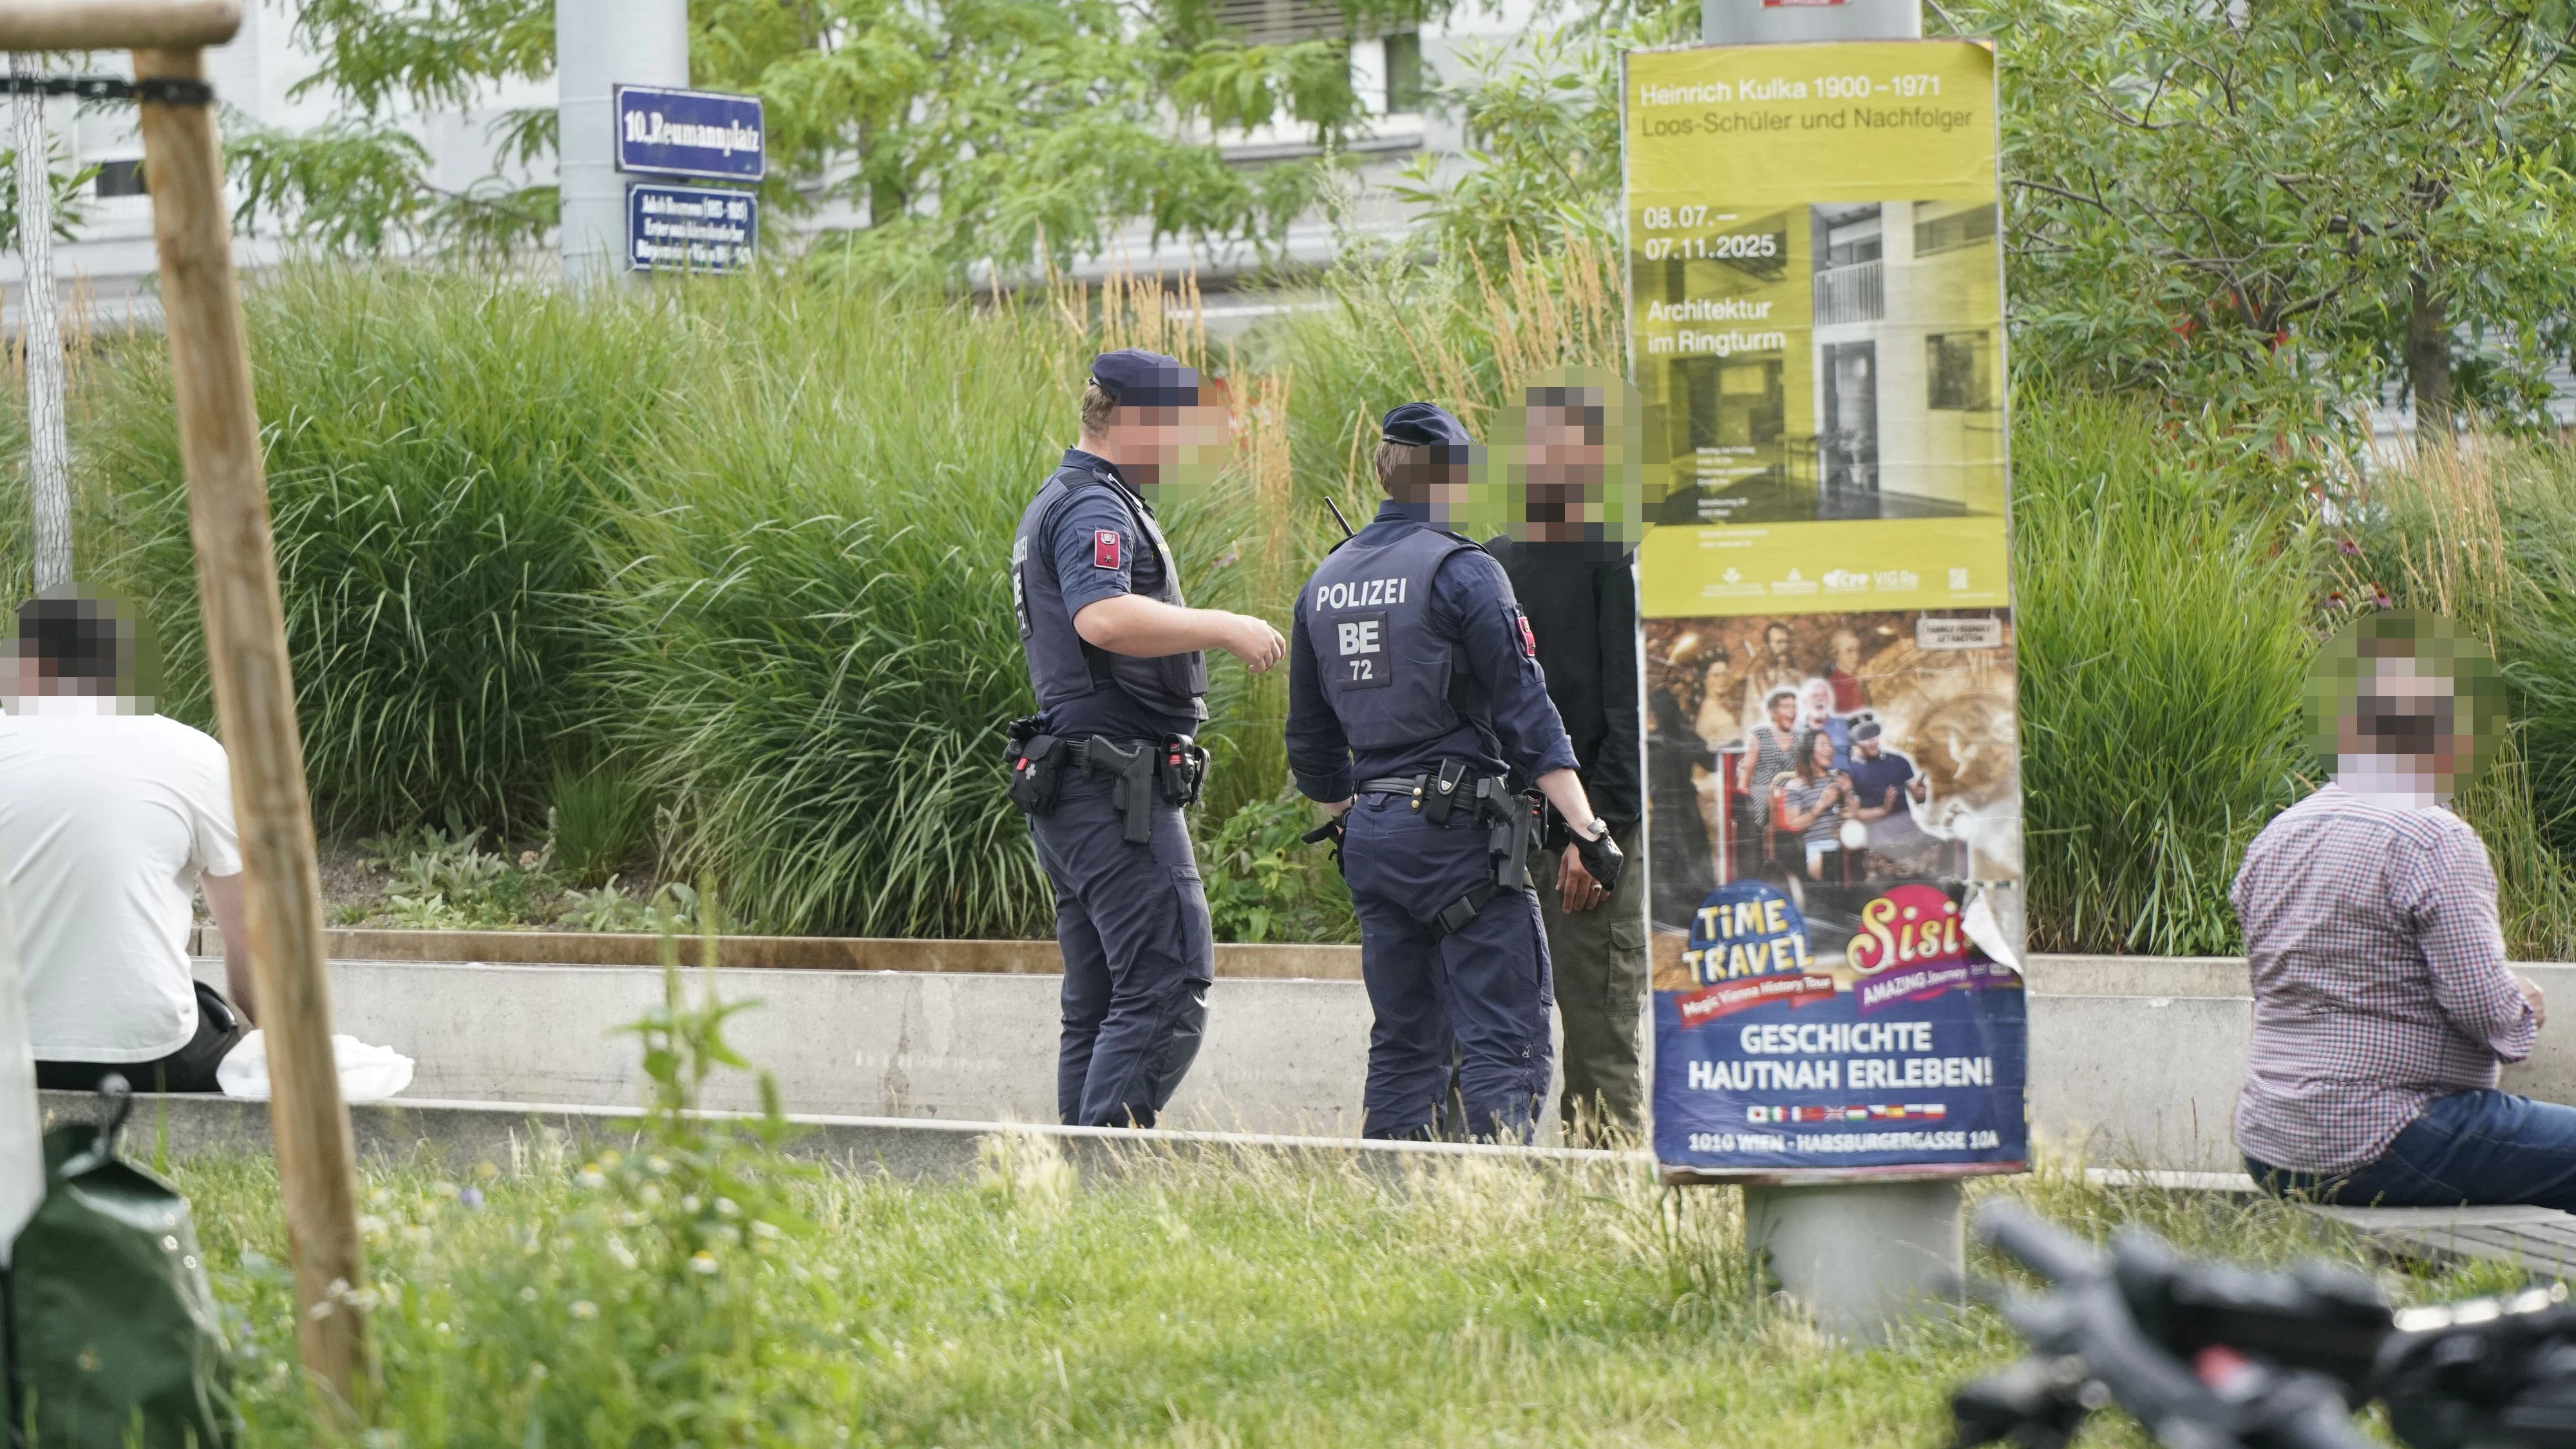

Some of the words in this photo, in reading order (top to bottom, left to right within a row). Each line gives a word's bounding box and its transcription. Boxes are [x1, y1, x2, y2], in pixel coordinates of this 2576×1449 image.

[1640, 80, 1731, 106] Heinrich
[1739, 77, 1807, 100] Kulka
[650, 111, 759, 158] Reumannplatz
[1642, 110, 1792, 137] Loos-Schüler
[1801, 108, 1846, 130] und
[1853, 106, 1973, 133] Nachfolger
[1645, 234, 1777, 260] 07.11.2025
[1647, 297, 1772, 321] Architektur
[1648, 332, 1674, 354] im
[1678, 330, 1786, 357] Ringturm
[1316, 578, 1406, 612] POLIZEI
[1338, 620, 1381, 656] BE
[1349, 659, 1373, 681] 72
[1681, 933, 1814, 984] TRAVEL
[1682, 996, 1719, 1018] Magic
[1718, 986, 1761, 1005] Vienna
[1760, 980, 1804, 995] History
[1803, 976, 1832, 990] Tour
[1864, 971, 1927, 1007] AMAZING
[1740, 1021, 1933, 1054] GESCHICHTE
[1688, 1059, 1840, 1090] HAUTNAH
[1848, 1056, 1994, 1089] ERLEBEN!
[1689, 1132, 1735, 1152] 1010
[1738, 1133, 1785, 1152] WIEN
[1797, 1130, 1967, 1152] HABSBURGERGASSE
[1969, 1129, 2000, 1149] 10A
